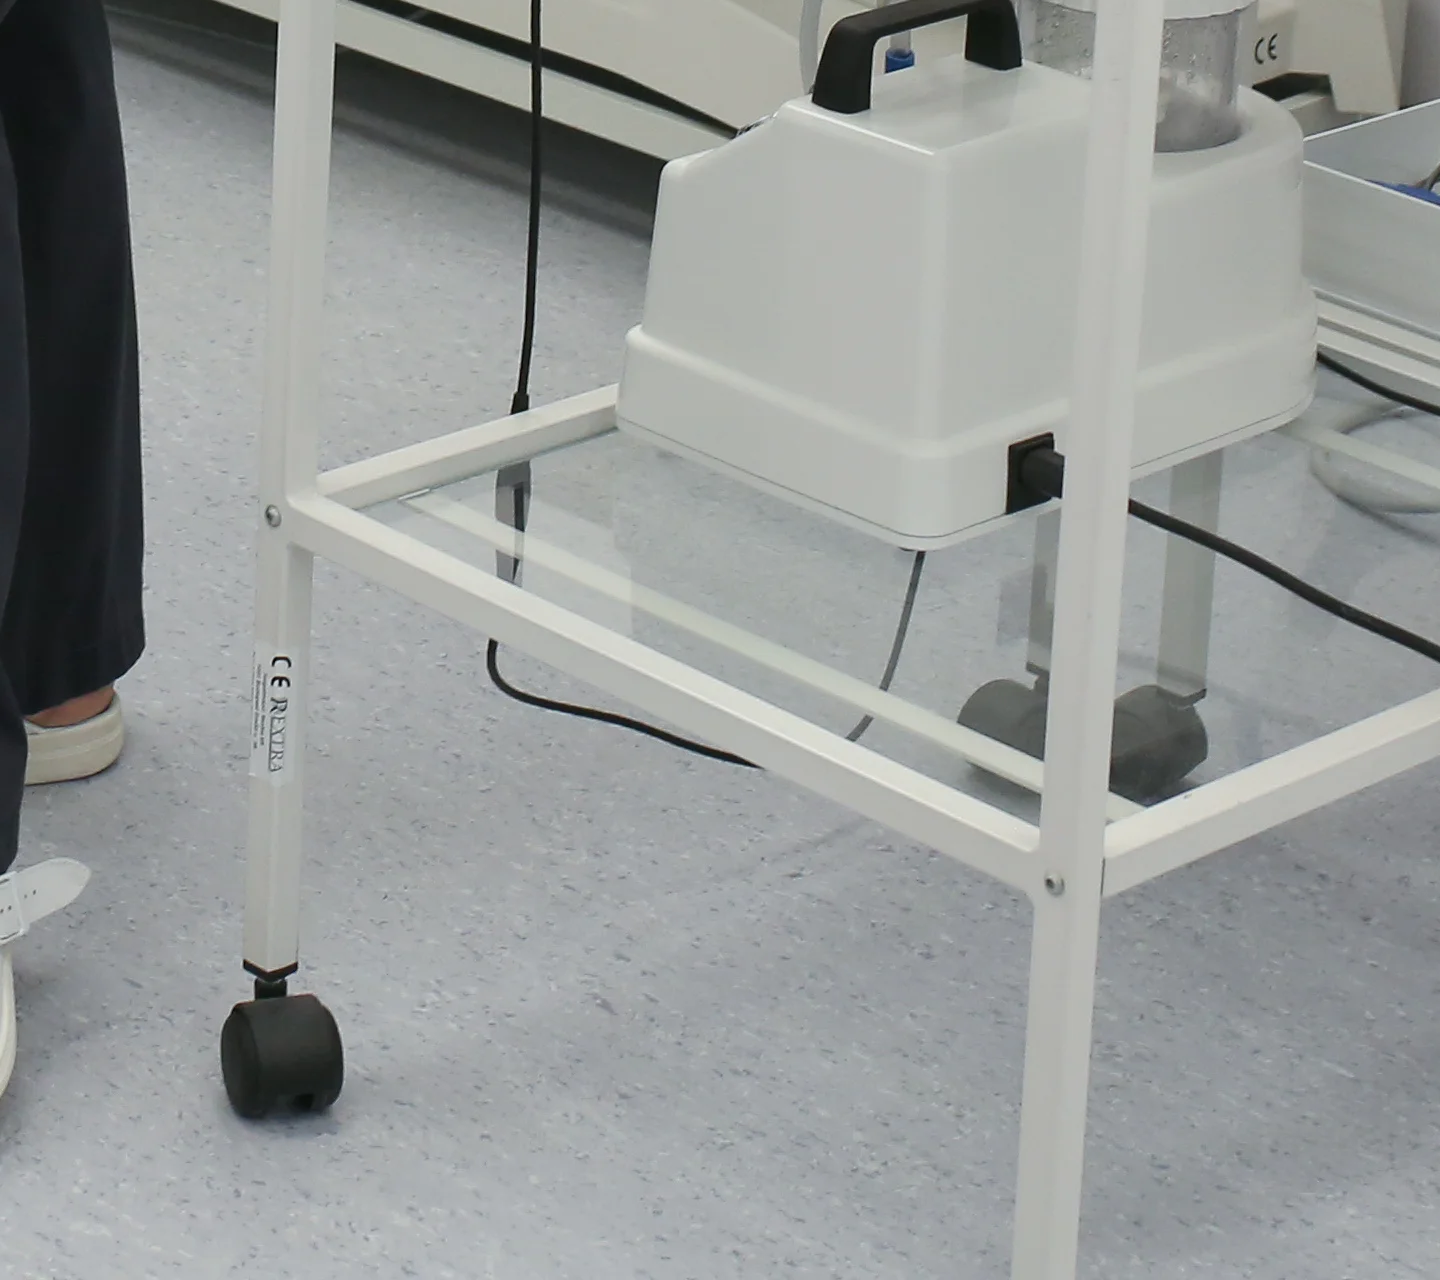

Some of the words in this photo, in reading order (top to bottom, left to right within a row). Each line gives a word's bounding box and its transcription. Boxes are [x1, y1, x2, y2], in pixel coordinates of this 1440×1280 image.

[1254, 33, 1278, 65] CE
[271, 655, 292, 688] CE
[268, 696, 288, 773] REXTRA
